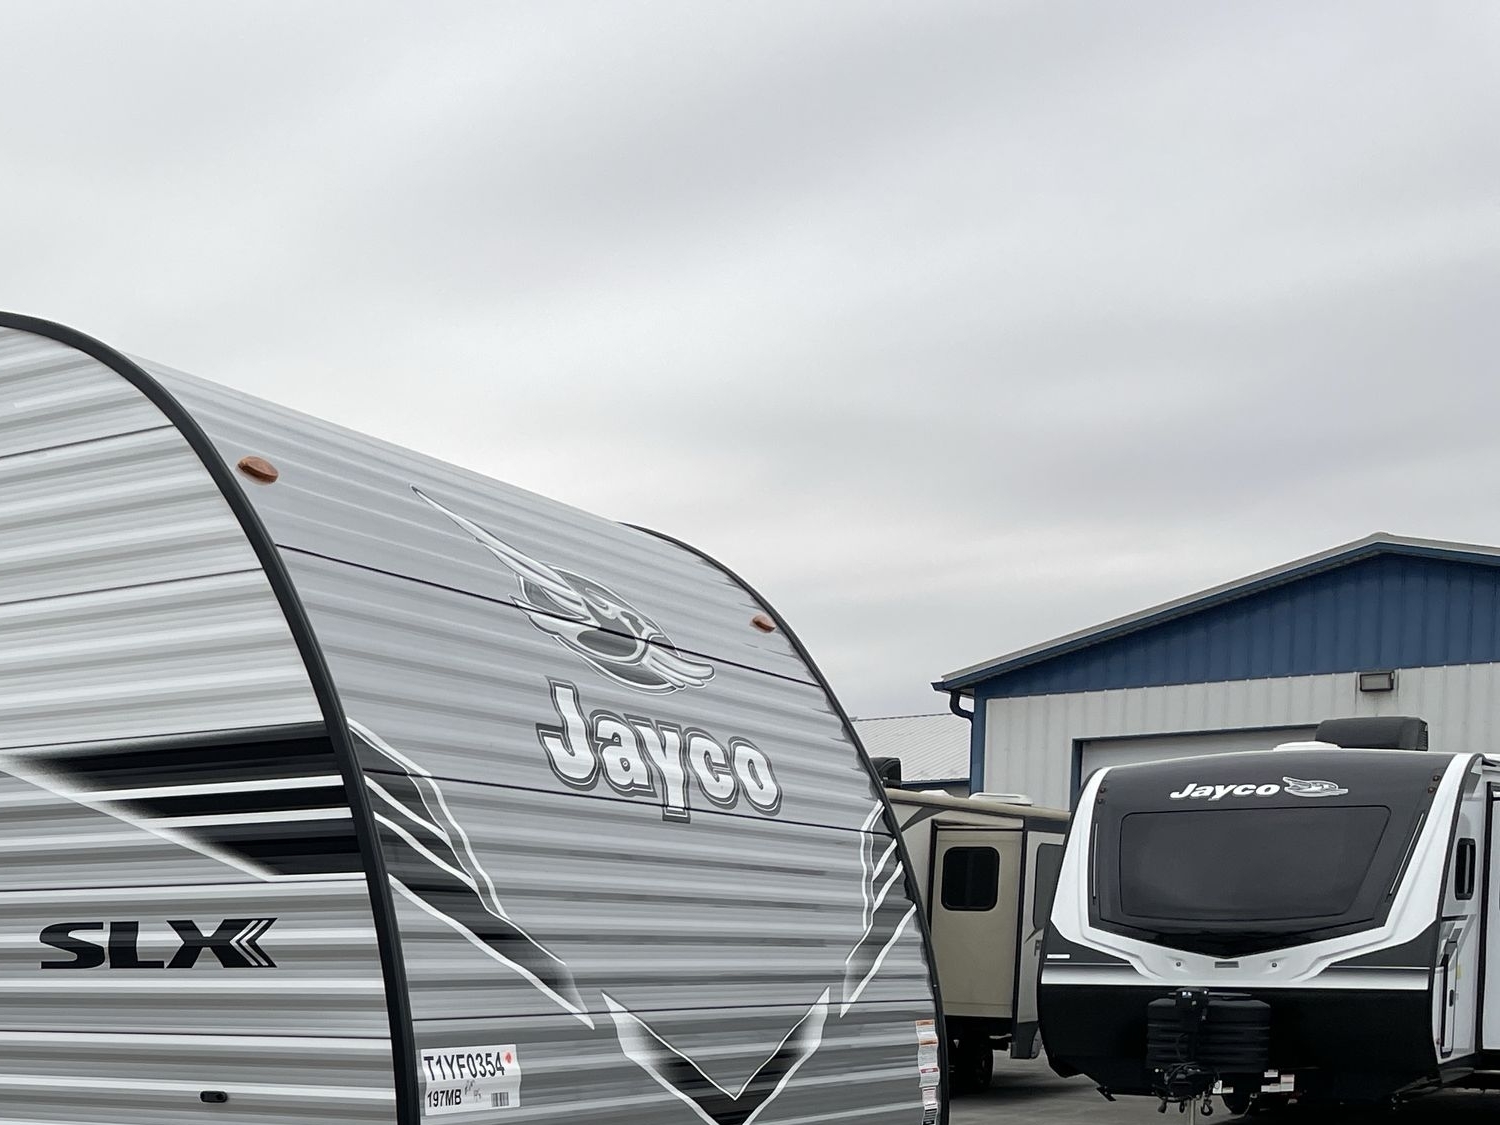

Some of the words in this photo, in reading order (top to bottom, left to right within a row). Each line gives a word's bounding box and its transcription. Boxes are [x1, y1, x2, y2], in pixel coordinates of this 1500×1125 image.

[536, 676, 782, 823] Jayco
[1170, 783, 1280, 801] Jayco
[39, 917, 278, 969] SLX
[424, 1052, 505, 1081] T1YF0354
[427, 1088, 462, 1108] 197MB
